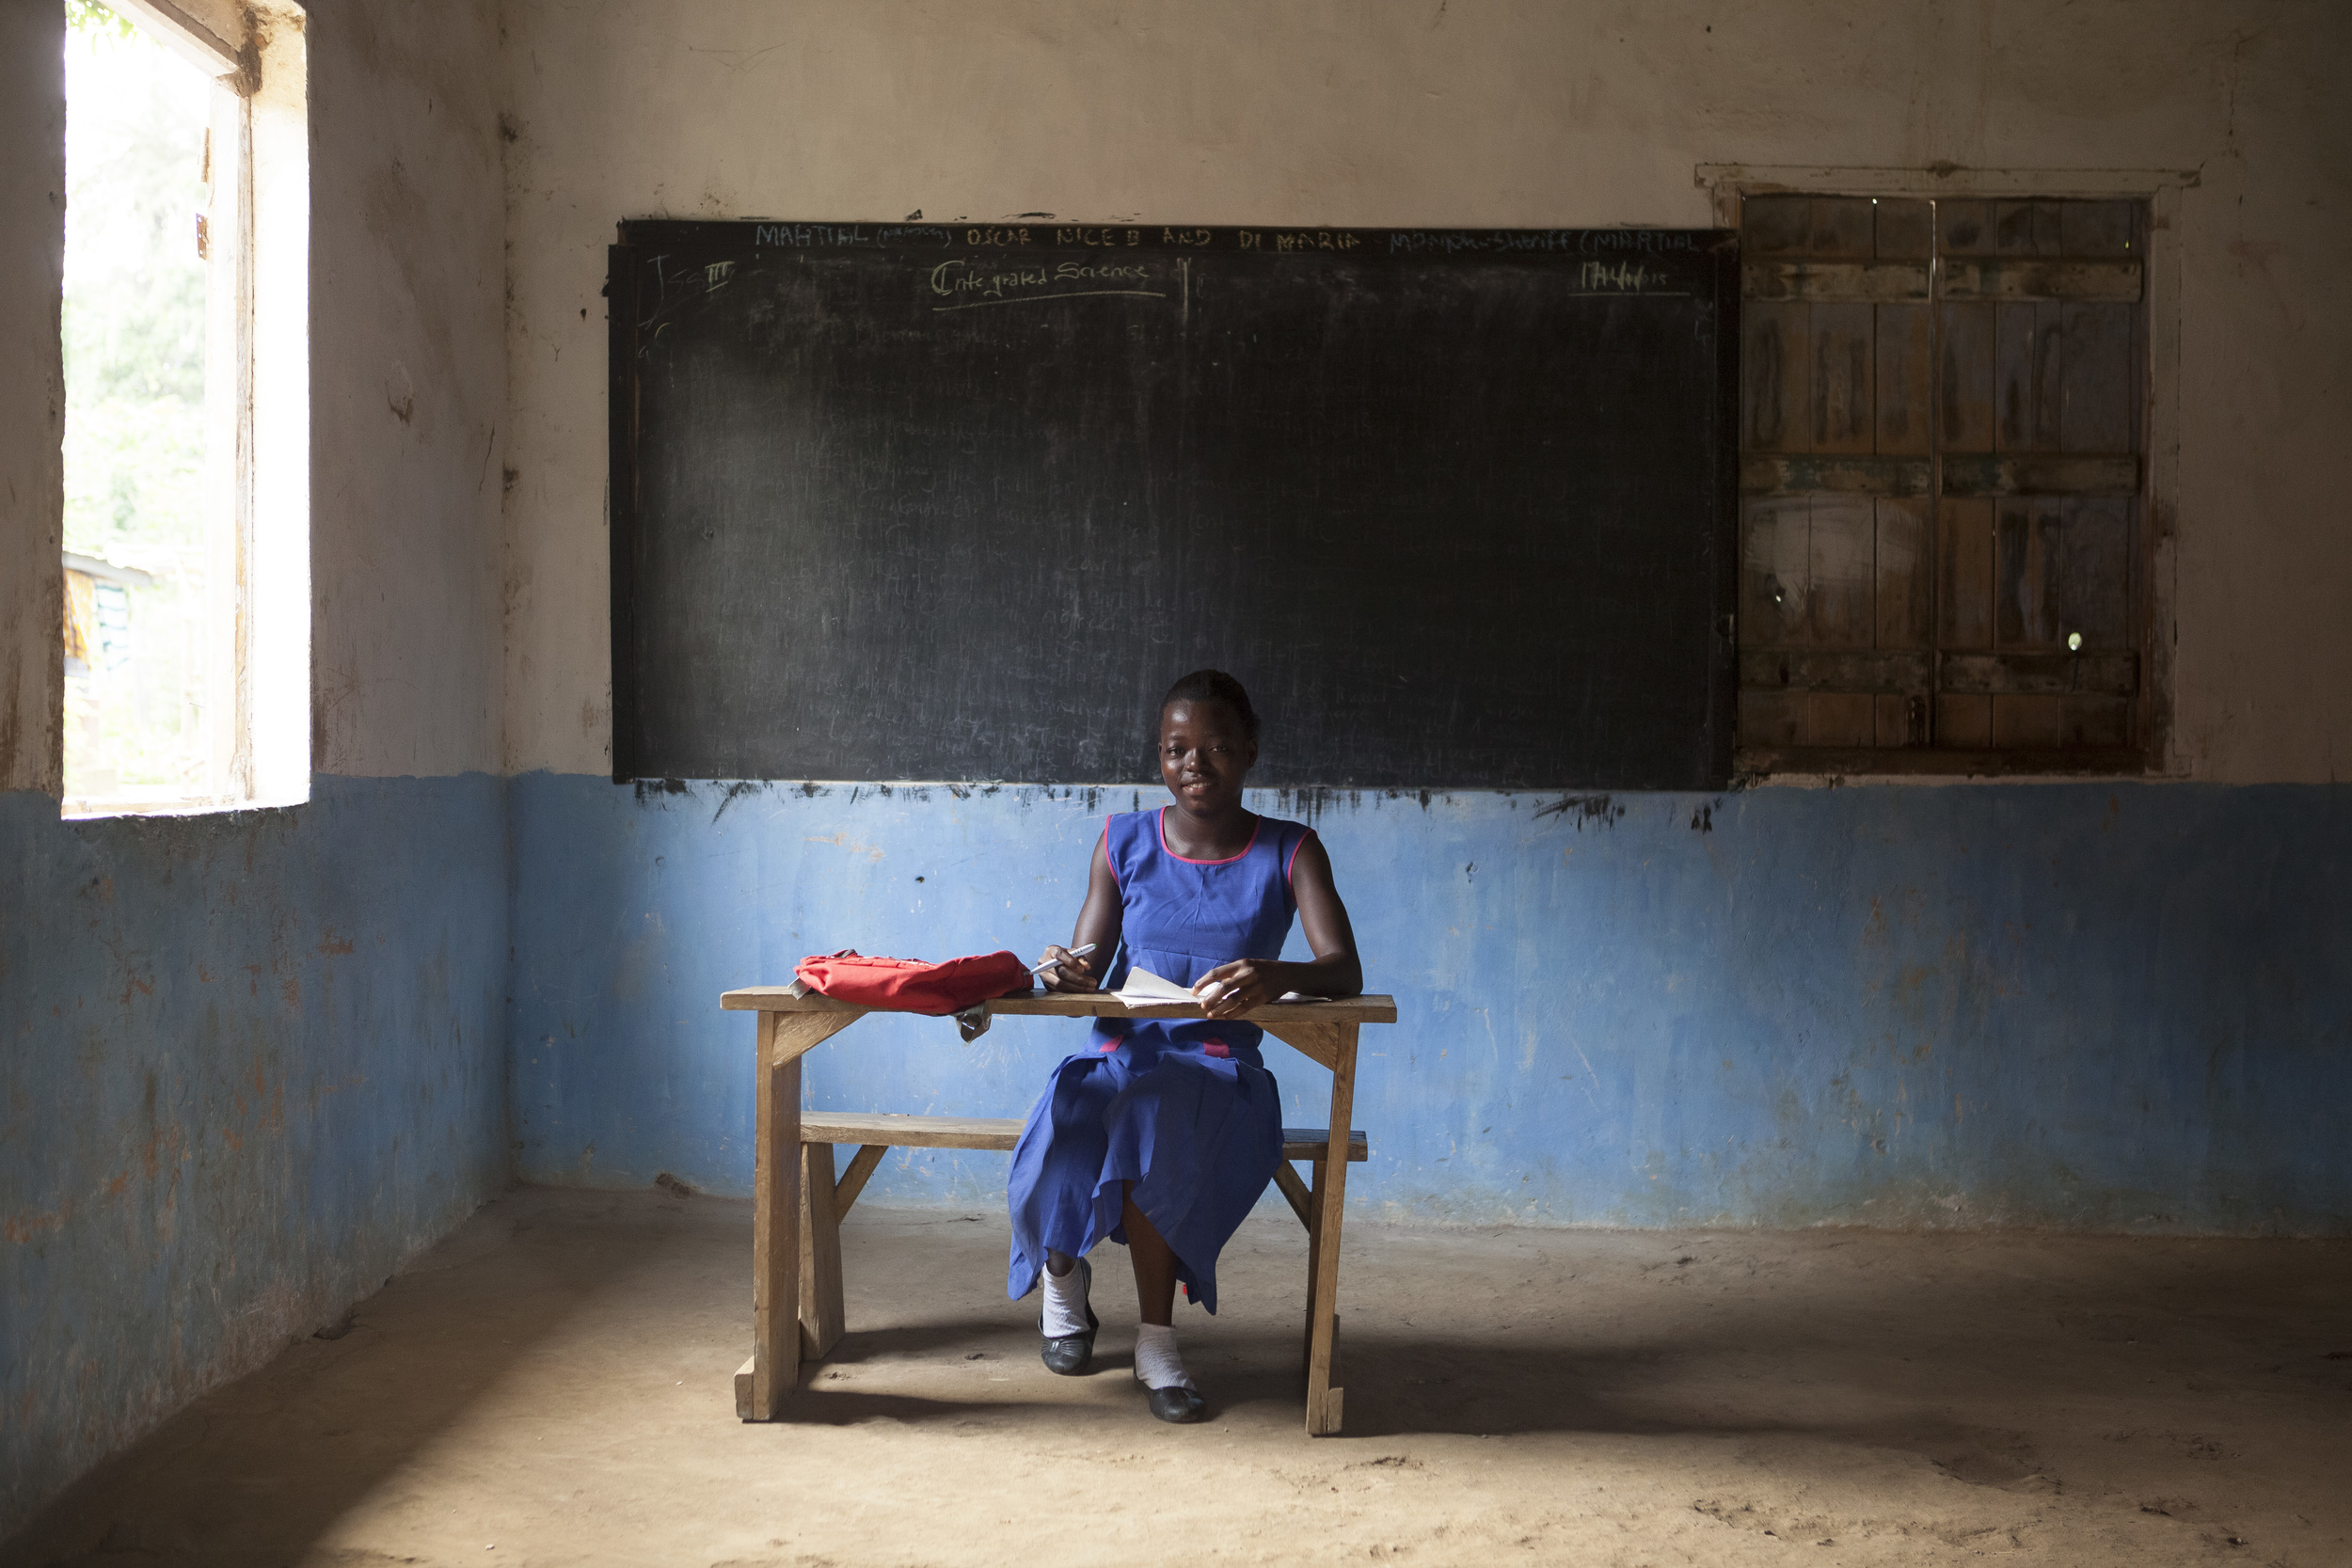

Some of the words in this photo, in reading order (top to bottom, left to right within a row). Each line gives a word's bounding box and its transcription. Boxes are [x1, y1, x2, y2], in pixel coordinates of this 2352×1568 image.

[967, 226, 1031, 246] OSCAR
[1057, 228, 1116, 246] NICE
[1163, 227, 1211, 245] AND
[1239, 230, 1262, 249] DI
[1277, 231, 1360, 252] MARIA
[931, 261, 1047, 296] Integrated
[1055, 262, 1150, 280] Science
